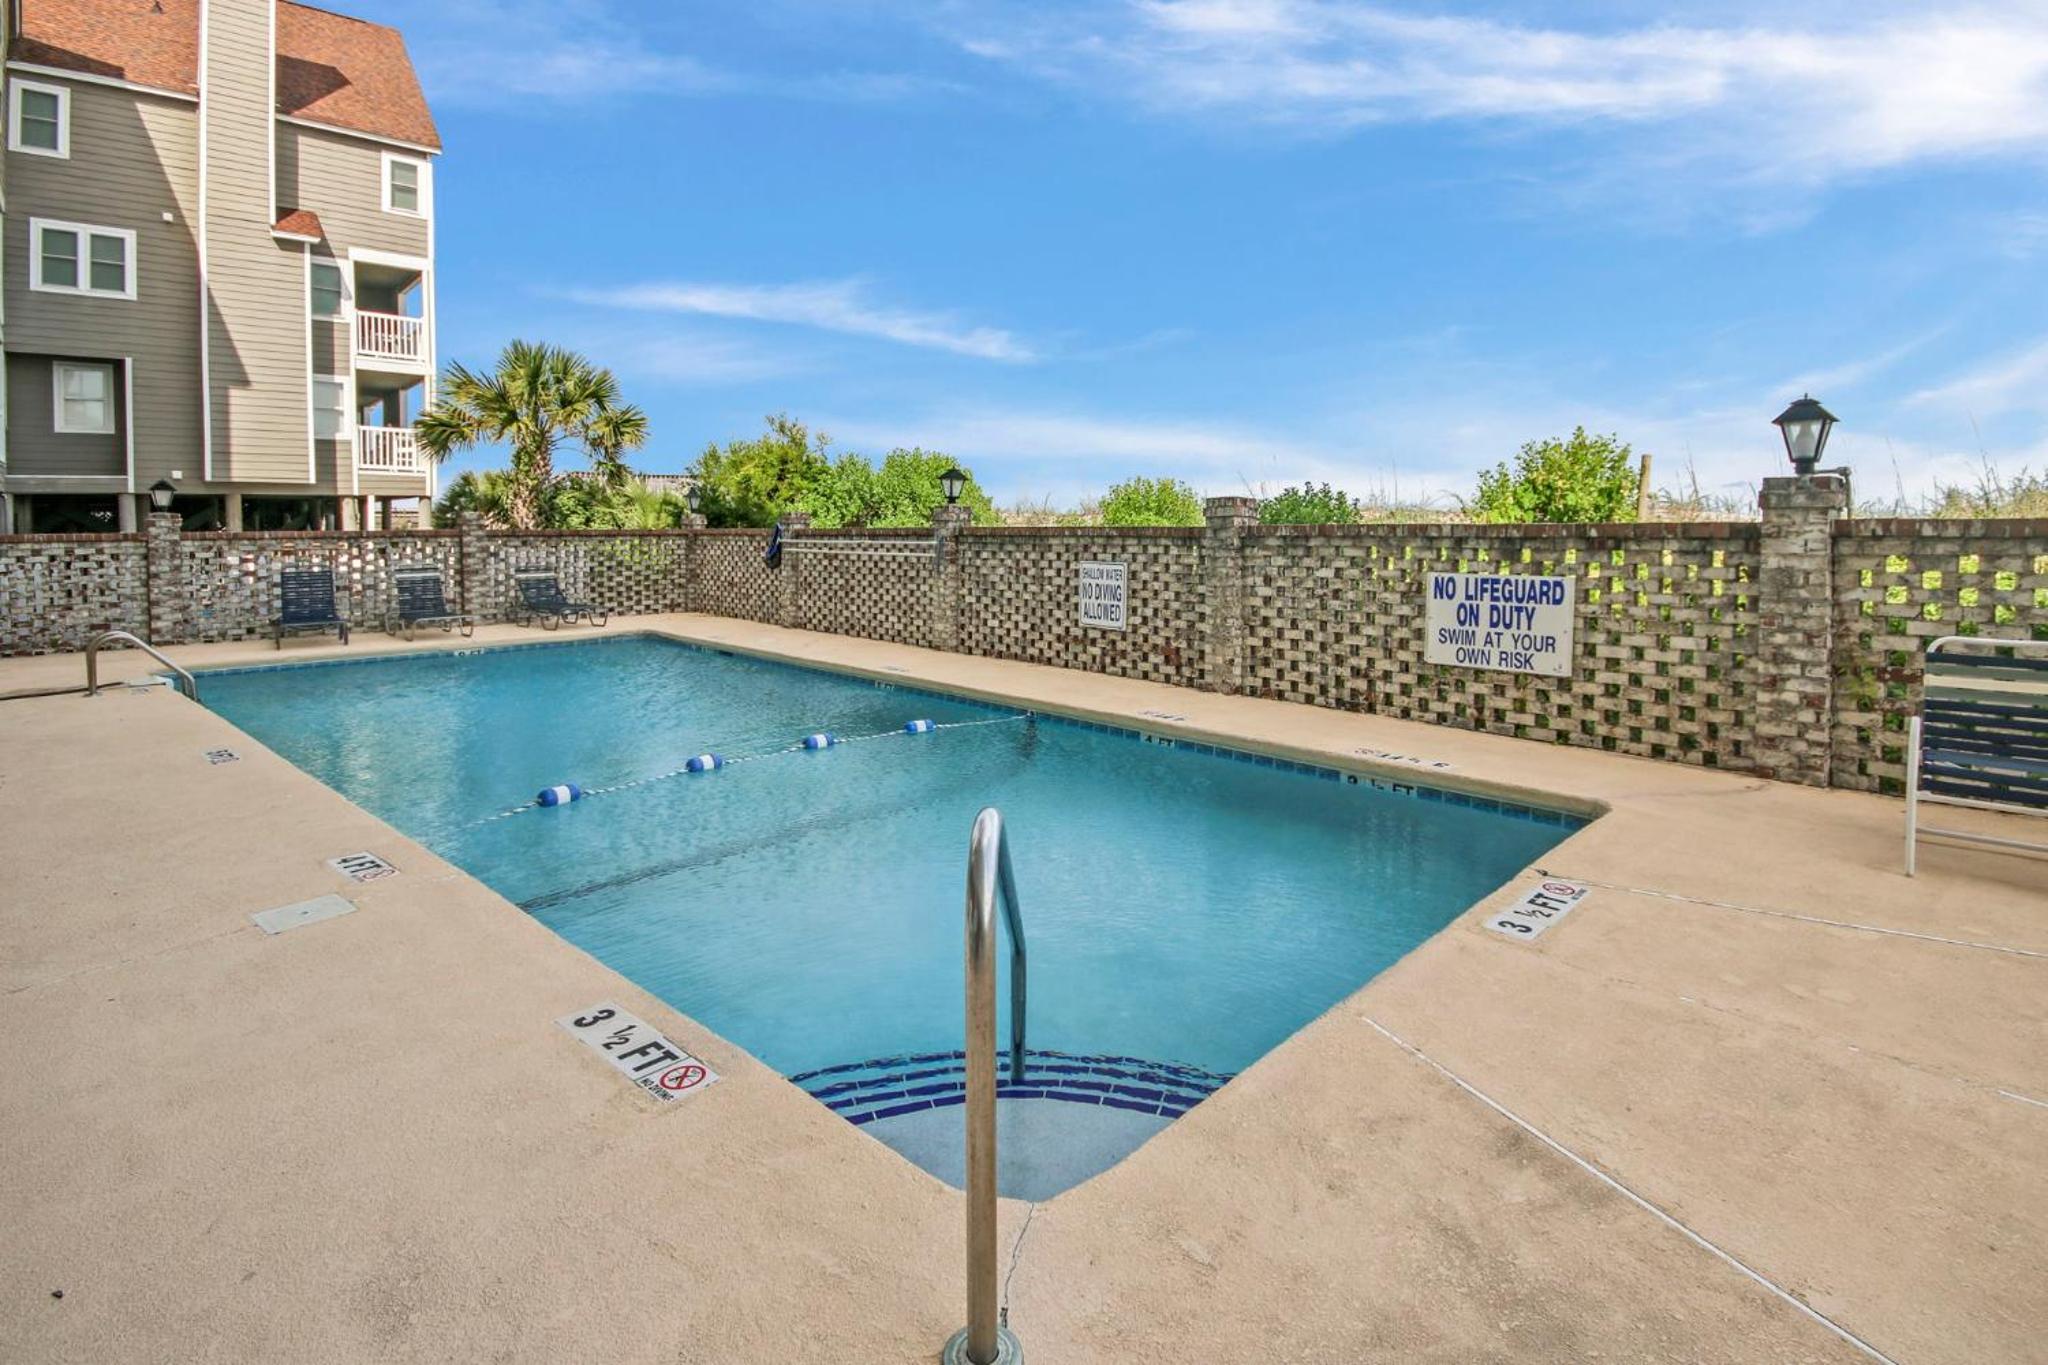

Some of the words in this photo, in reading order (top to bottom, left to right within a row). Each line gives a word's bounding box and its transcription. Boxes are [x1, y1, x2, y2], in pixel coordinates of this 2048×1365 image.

[1083, 567, 1104, 580] SHALLOW
[1105, 569, 1122, 581] WATER
[1082, 582, 1093, 600] NO
[1095, 583, 1122, 602] DIVING
[1434, 576, 1456, 600] NO
[1464, 577, 1565, 605] LIFEGUARD
[1084, 602, 1121, 621] ALLOWED
[1456, 602, 1480, 627] ON
[1489, 604, 1536, 631] DUTY
[1438, 628, 1476, 646] SWIM
[1483, 632, 1503, 648] AT
[1512, 633, 1556, 653] YOUR
[1456, 647, 1491, 666] OWN
[1499, 651, 1534, 670] RISK
[336, 854, 369, 866] 4
[343, 860, 383, 874] FT
[1498, 920, 1533, 934] 3
[1527, 892, 1568, 912] FT
[573, 1008, 616, 1028] 3
[617, 1040, 680, 1073] FT
